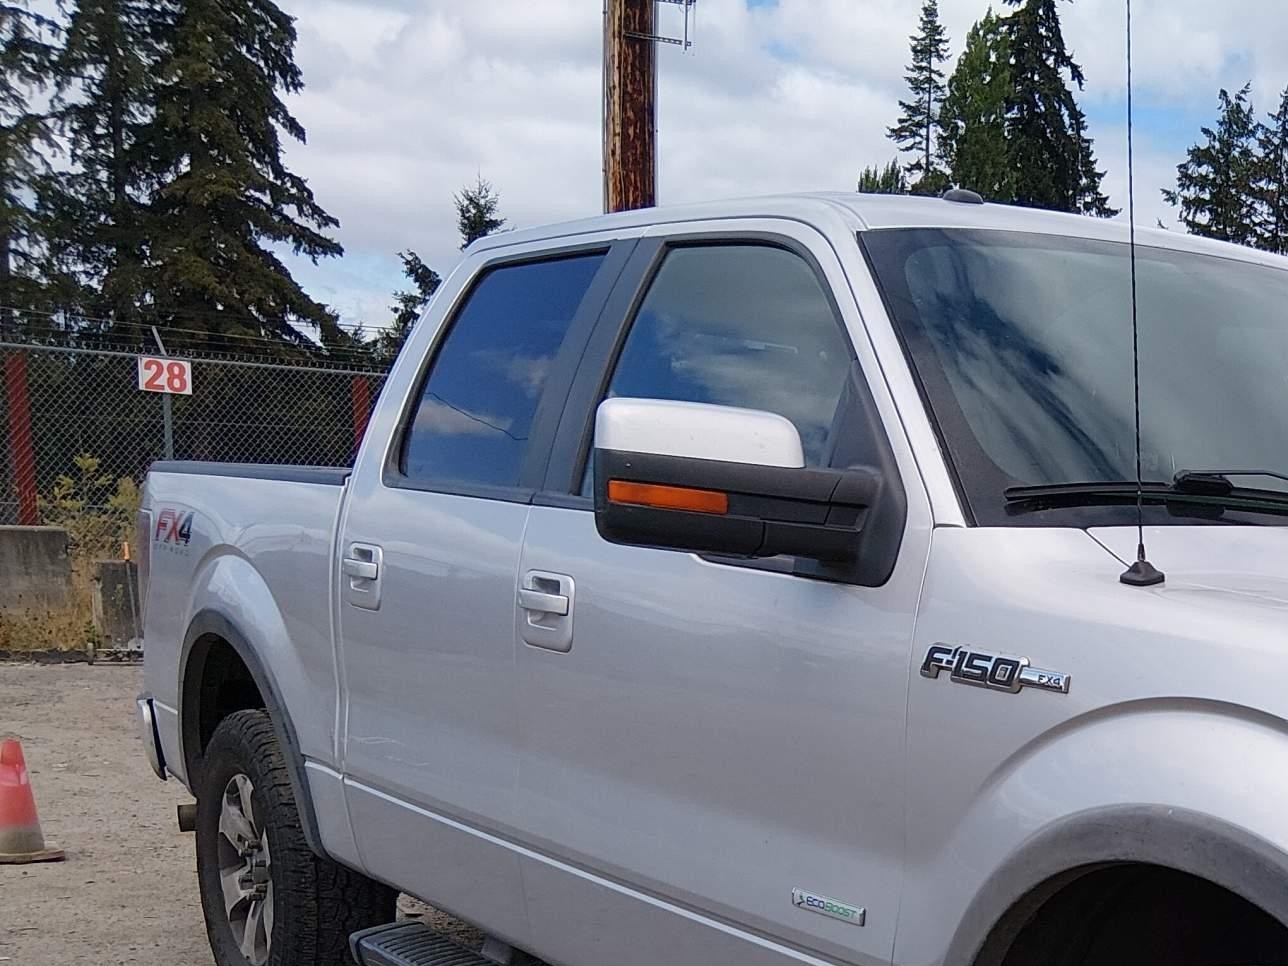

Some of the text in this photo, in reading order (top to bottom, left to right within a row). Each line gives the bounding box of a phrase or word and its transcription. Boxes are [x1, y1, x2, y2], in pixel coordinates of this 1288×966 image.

[143, 359, 188, 393] 28
[155, 508, 195, 546] FX4
[1037, 673, 1062, 688] FX4
